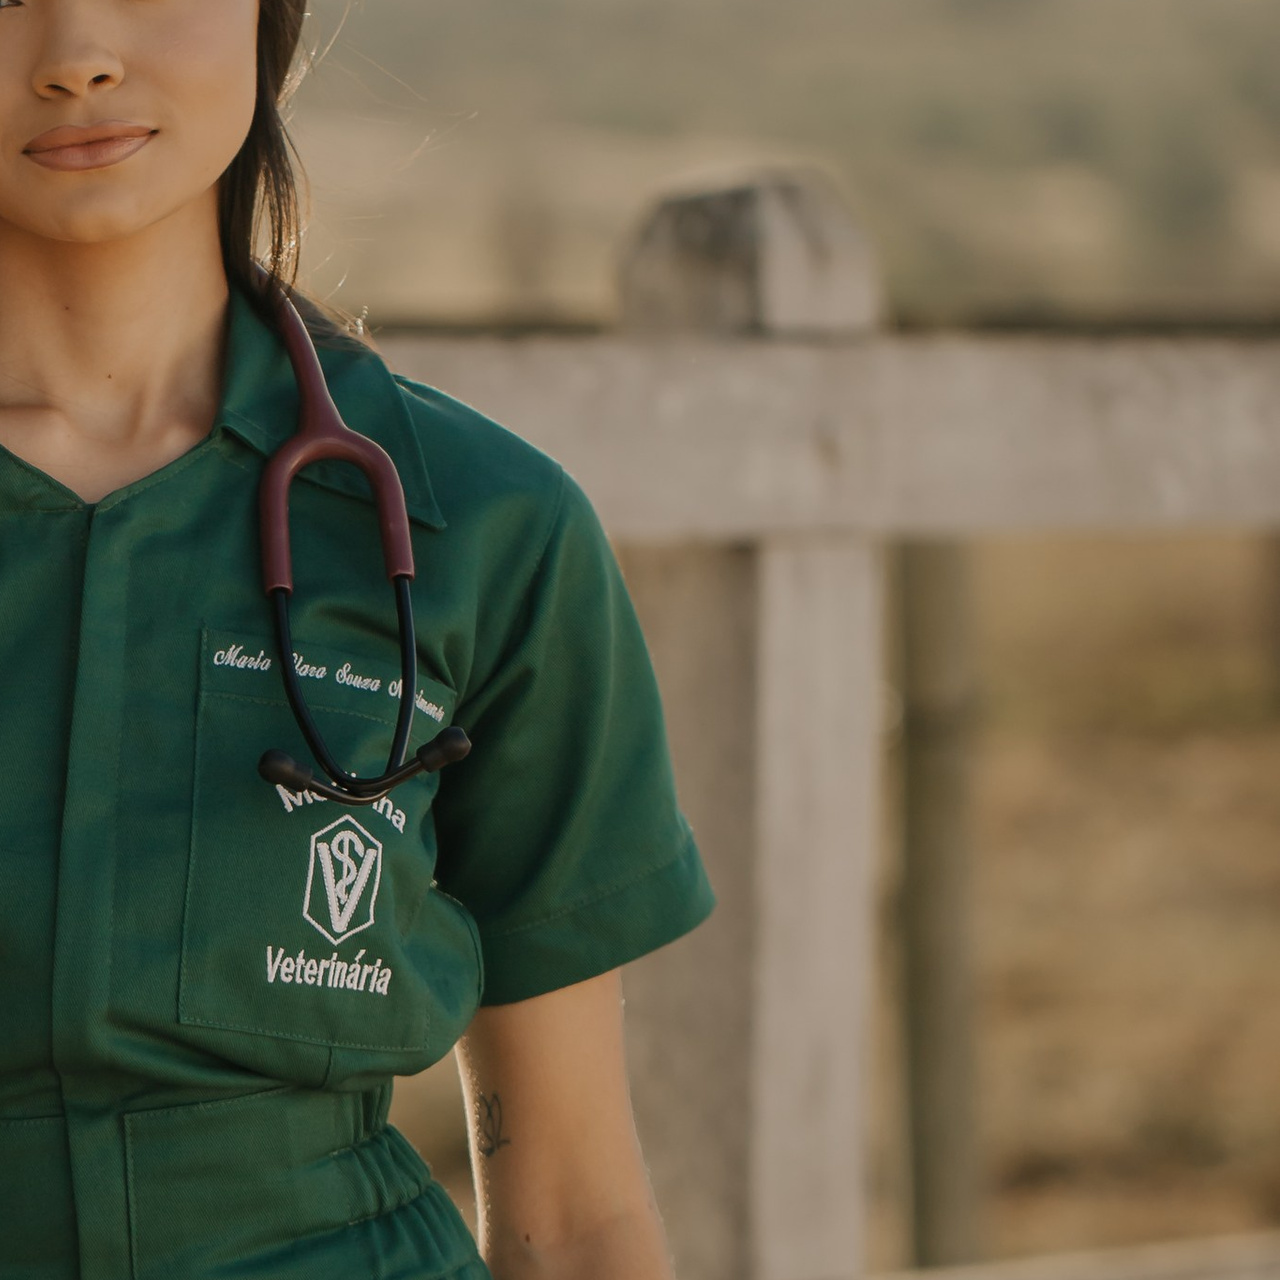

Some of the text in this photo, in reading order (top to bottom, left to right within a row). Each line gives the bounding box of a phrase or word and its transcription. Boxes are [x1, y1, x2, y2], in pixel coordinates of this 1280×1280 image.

[214, 645, 271, 671] Maria
[336, 663, 382, 692] Souza
[266, 945, 392, 995] Veterinária
